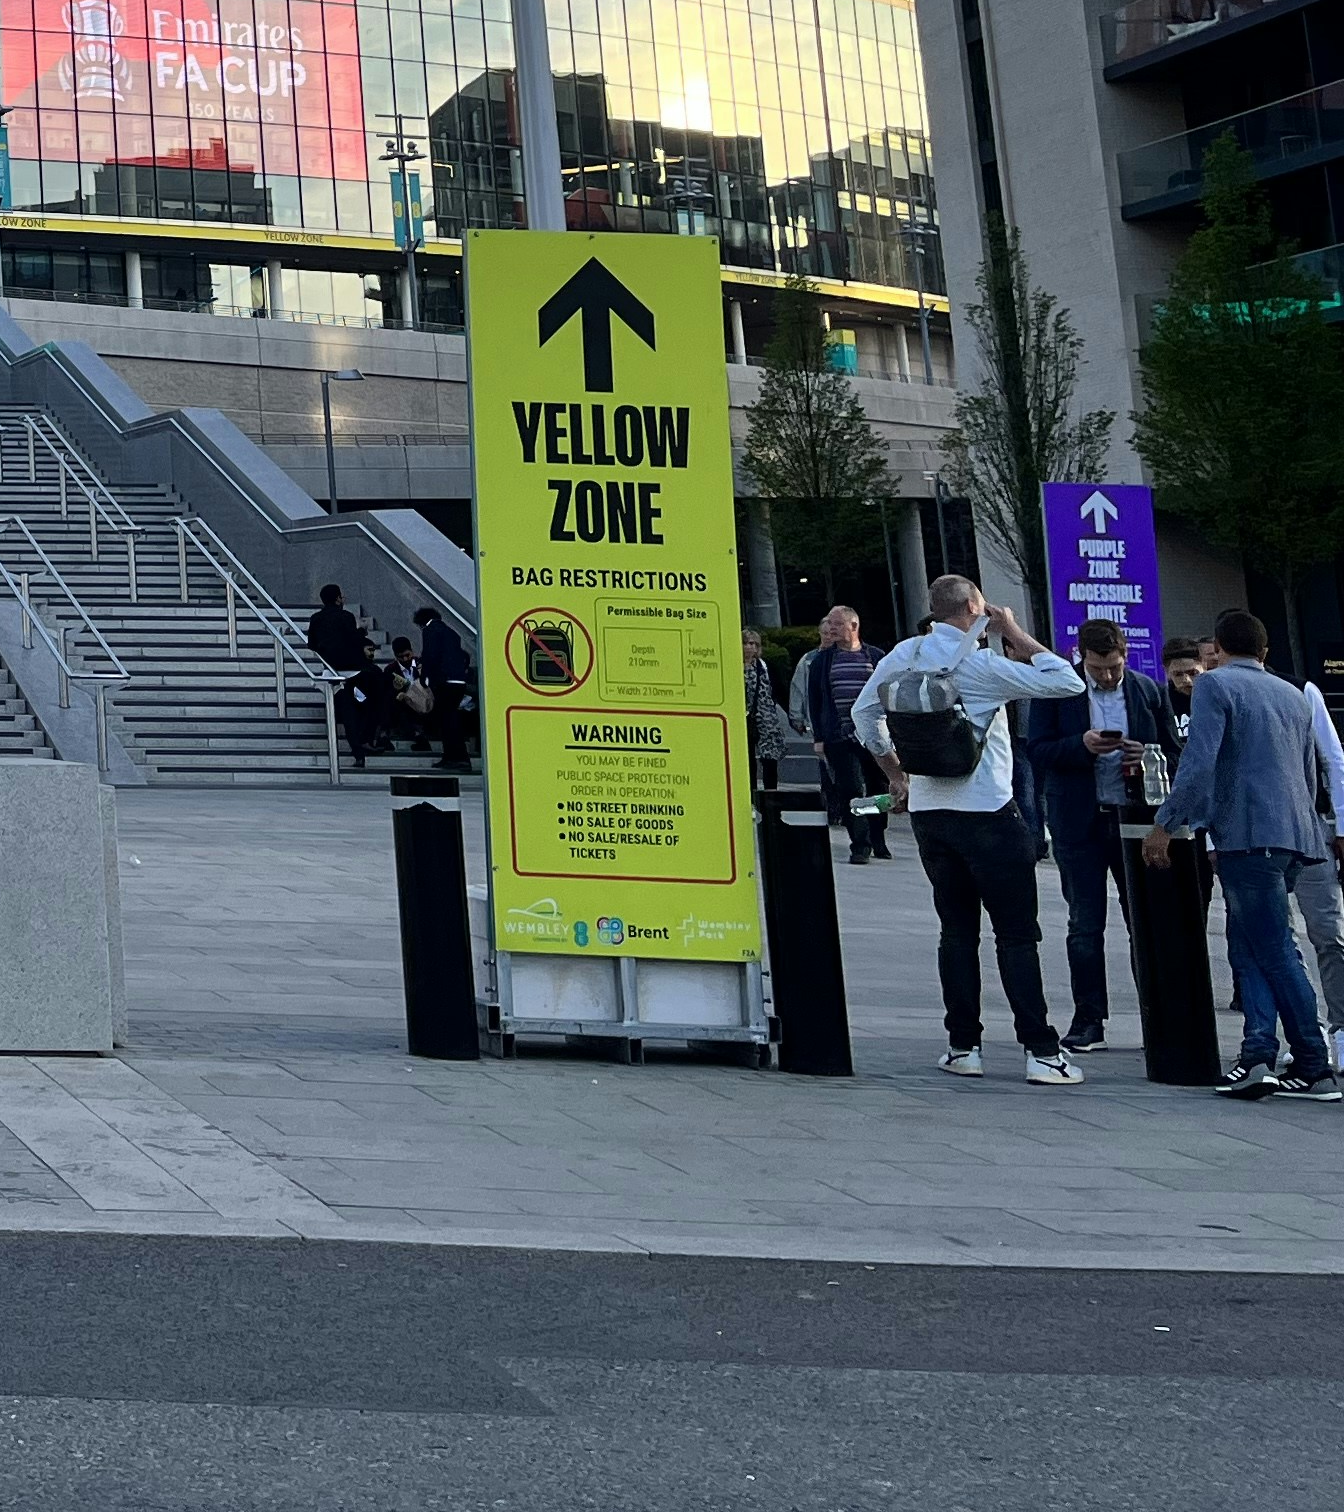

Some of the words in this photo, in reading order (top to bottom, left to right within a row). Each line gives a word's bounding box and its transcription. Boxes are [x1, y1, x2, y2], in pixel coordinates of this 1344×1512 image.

[151, 9, 304, 56] Emirates
[155, 51, 210, 92] FA
[215, 55, 307, 98] CUP
[21, 218, 47, 228] ZONE
[264, 231, 299, 243] YELLOW
[301, 233, 324, 244] ZONE
[512, 401, 690, 469] YELLOW
[547, 479, 664, 545] ZONE
[1078, 539, 1127, 559] PURPLE
[1087, 559, 1121, 579] ZONE
[512, 566, 553, 586] BAG
[559, 568, 707, 592] RESTRICTIONS
[1069, 582, 1143, 604] ACCESSIBLE
[607, 606, 663, 618] Permissible
[666, 608, 684, 620] Bag
[686, 608, 707, 619] Size
[631, 644, 656, 655] Depth
[688, 647, 715, 658] Height
[628, 657, 660, 667] 210mm
[616, 686, 641, 696] Width
[642, 687, 674, 697] 210mm
[571, 724, 662, 745] WARNING
[576, 754, 597, 766] YOU
[598, 755, 621, 767] MAY
[622, 756, 636, 768] BE
[637, 757, 667, 769] FINED
[556, 770, 592, 782] PUBLIC
[593, 771, 625, 783] SPACE
[627, 773, 690, 786] PROTECTION
[570, 785, 604, 797] ORDER
[606, 786, 617, 797] IN
[619, 787, 675, 800] OPERATION
[566, 801, 583, 812] NO
[586, 801, 628, 814] STREET
[630, 803, 685, 817] DRINKING
[567, 816, 584, 827] NO
[586, 816, 615, 829] SALE
[617, 818, 632, 830] OF
[635, 819, 674, 831] GOODS
[568, 831, 585, 843] NO
[587, 832, 662, 846] SALE/RESALE
[664, 834, 680, 847] OF
[569, 847, 616, 860] TICKETS
[503, 921, 570, 936] WEMBLEY
[627, 924, 670, 940] Brent
